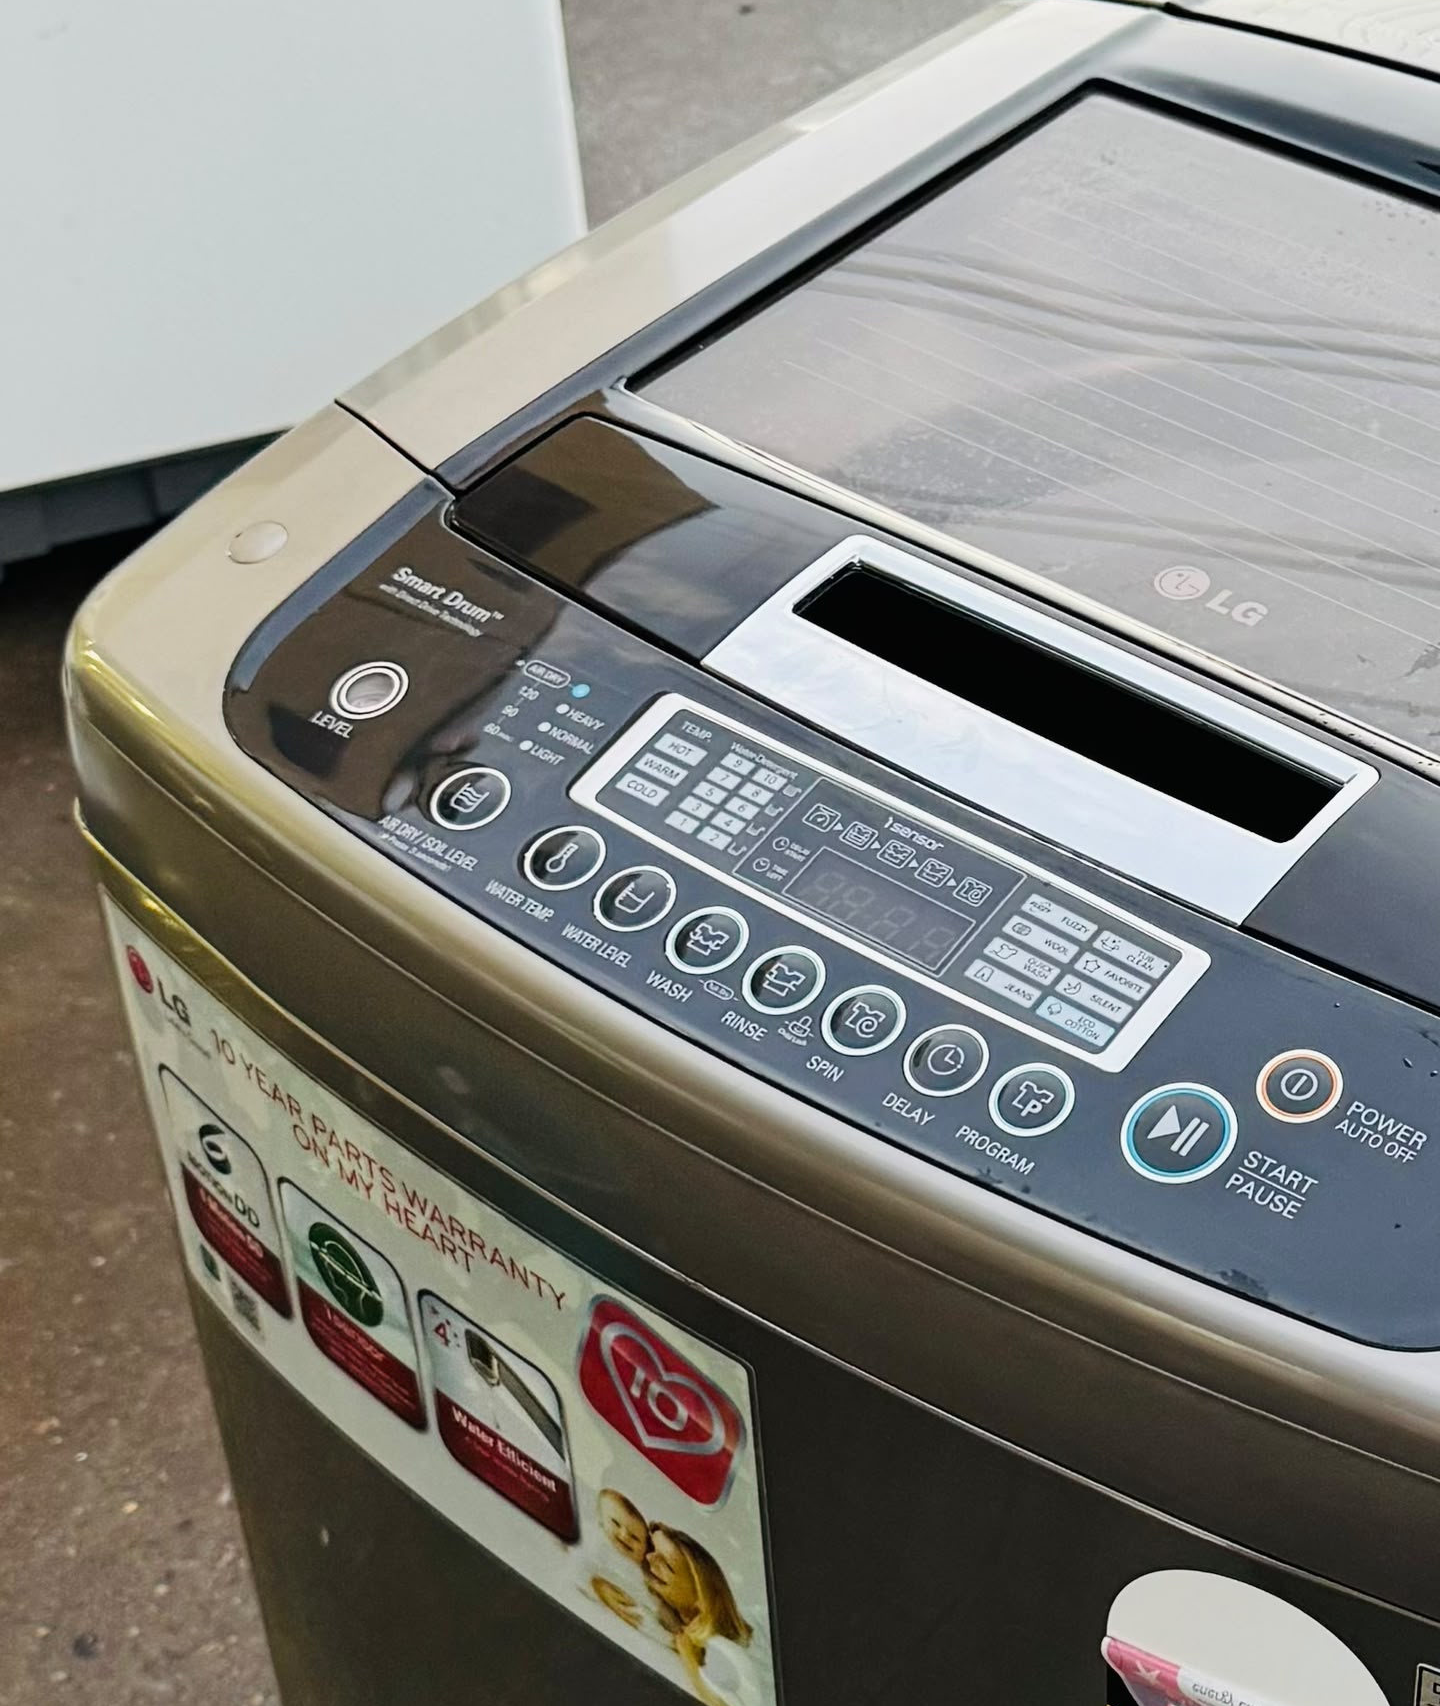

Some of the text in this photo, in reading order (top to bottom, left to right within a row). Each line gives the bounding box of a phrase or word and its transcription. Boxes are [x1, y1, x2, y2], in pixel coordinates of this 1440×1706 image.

[392, 566, 446, 600] Smart
[1205, 589, 1268, 627] LG
[311, 710, 353, 740] LEVEL
[565, 707, 605, 731] HEAVY
[681, 720, 713, 743] TEMP.
[529, 744, 566, 766] LIGHT
[548, 726, 596, 755] NORMAL
[667, 742, 694, 758] HOT
[643, 757, 681, 781] WARM
[762, 772, 778, 786] 10
[627, 779, 659, 800] COLD
[377, 814, 401, 832] AIR
[397, 822, 424, 842] DRY
[421, 836, 449, 859] SOIL
[443, 848, 479, 873] LEVEL
[484, 878, 557, 924] WATER TEMP.
[1060, 916, 1090, 935] FUZZY
[560, 922, 633, 969] WATER LEVEL
[1044, 938, 1070, 957] WOOL
[645, 969, 694, 1004] WASH
[1004, 983, 1034, 1003] JEANS
[1104, 970, 1145, 994] FAVORITE
[157, 975, 192, 1028] LG
[1089, 994, 1122, 1015] SILENT
[720, 1010, 769, 1043] RINSE
[1064, 1019, 1101, 1041] COTTON
[805, 1055, 845, 1083] SPIN
[882, 1092, 937, 1127] DELAY
[1346, 1100, 1428, 1151] POWER
[955, 1124, 1037, 1176] PROGRAM
[1334, 1119, 1418, 1164] AUTO OFF
[210, 1028, 237, 1066] 10
[240, 1052, 304, 1125] YEAR
[310, 1112, 397, 1195] PARTS
[402, 1180, 566, 1311] WARRANTY
[1243, 1150, 1319, 1194] START
[293, 1123, 475, 1274] ON MY HEART
[1225, 1173, 1302, 1219] PAUSE
[451, 1405, 495, 1449] Water
[497, 1439, 557, 1493] Efficient
